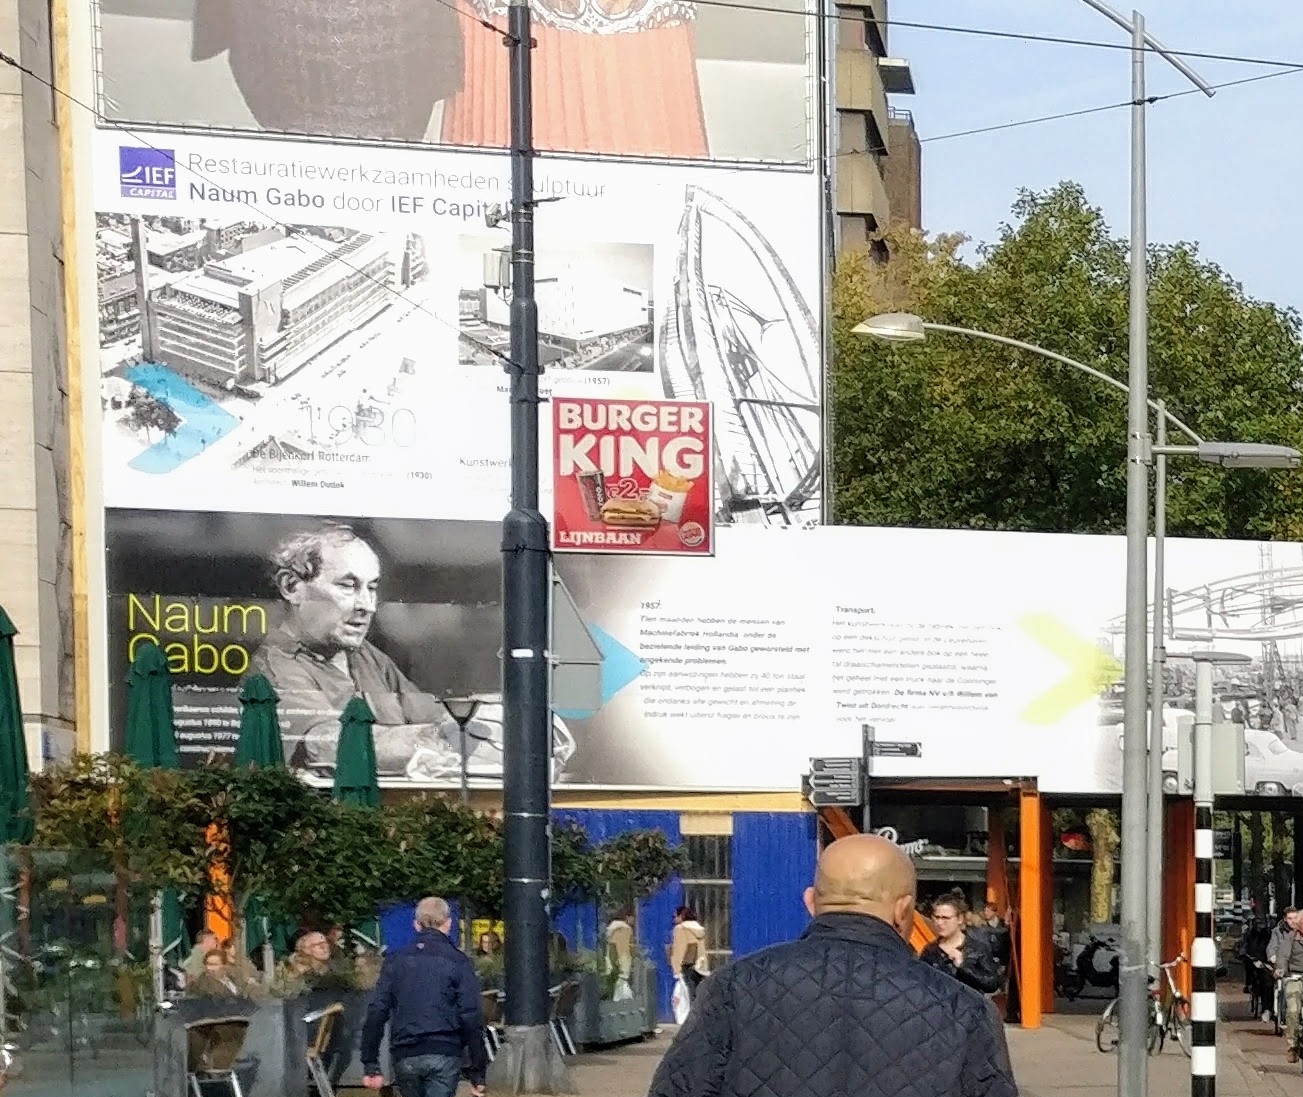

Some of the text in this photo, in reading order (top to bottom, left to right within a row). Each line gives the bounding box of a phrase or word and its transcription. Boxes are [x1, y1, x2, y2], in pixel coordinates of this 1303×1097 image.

[145, 165, 175, 185] IEF
[188, 153, 606, 199] Restauratiewerkzaamheden sulptuur
[129, 187, 174, 198] CAPITAL
[190, 183, 508, 221] Naum Gabo door IEF Capitl
[559, 402, 704, 433] BURGER
[559, 433, 704, 480] KING
[559, 531, 642, 545] LIJNBAAN
[128, 593, 267, 634] Naum
